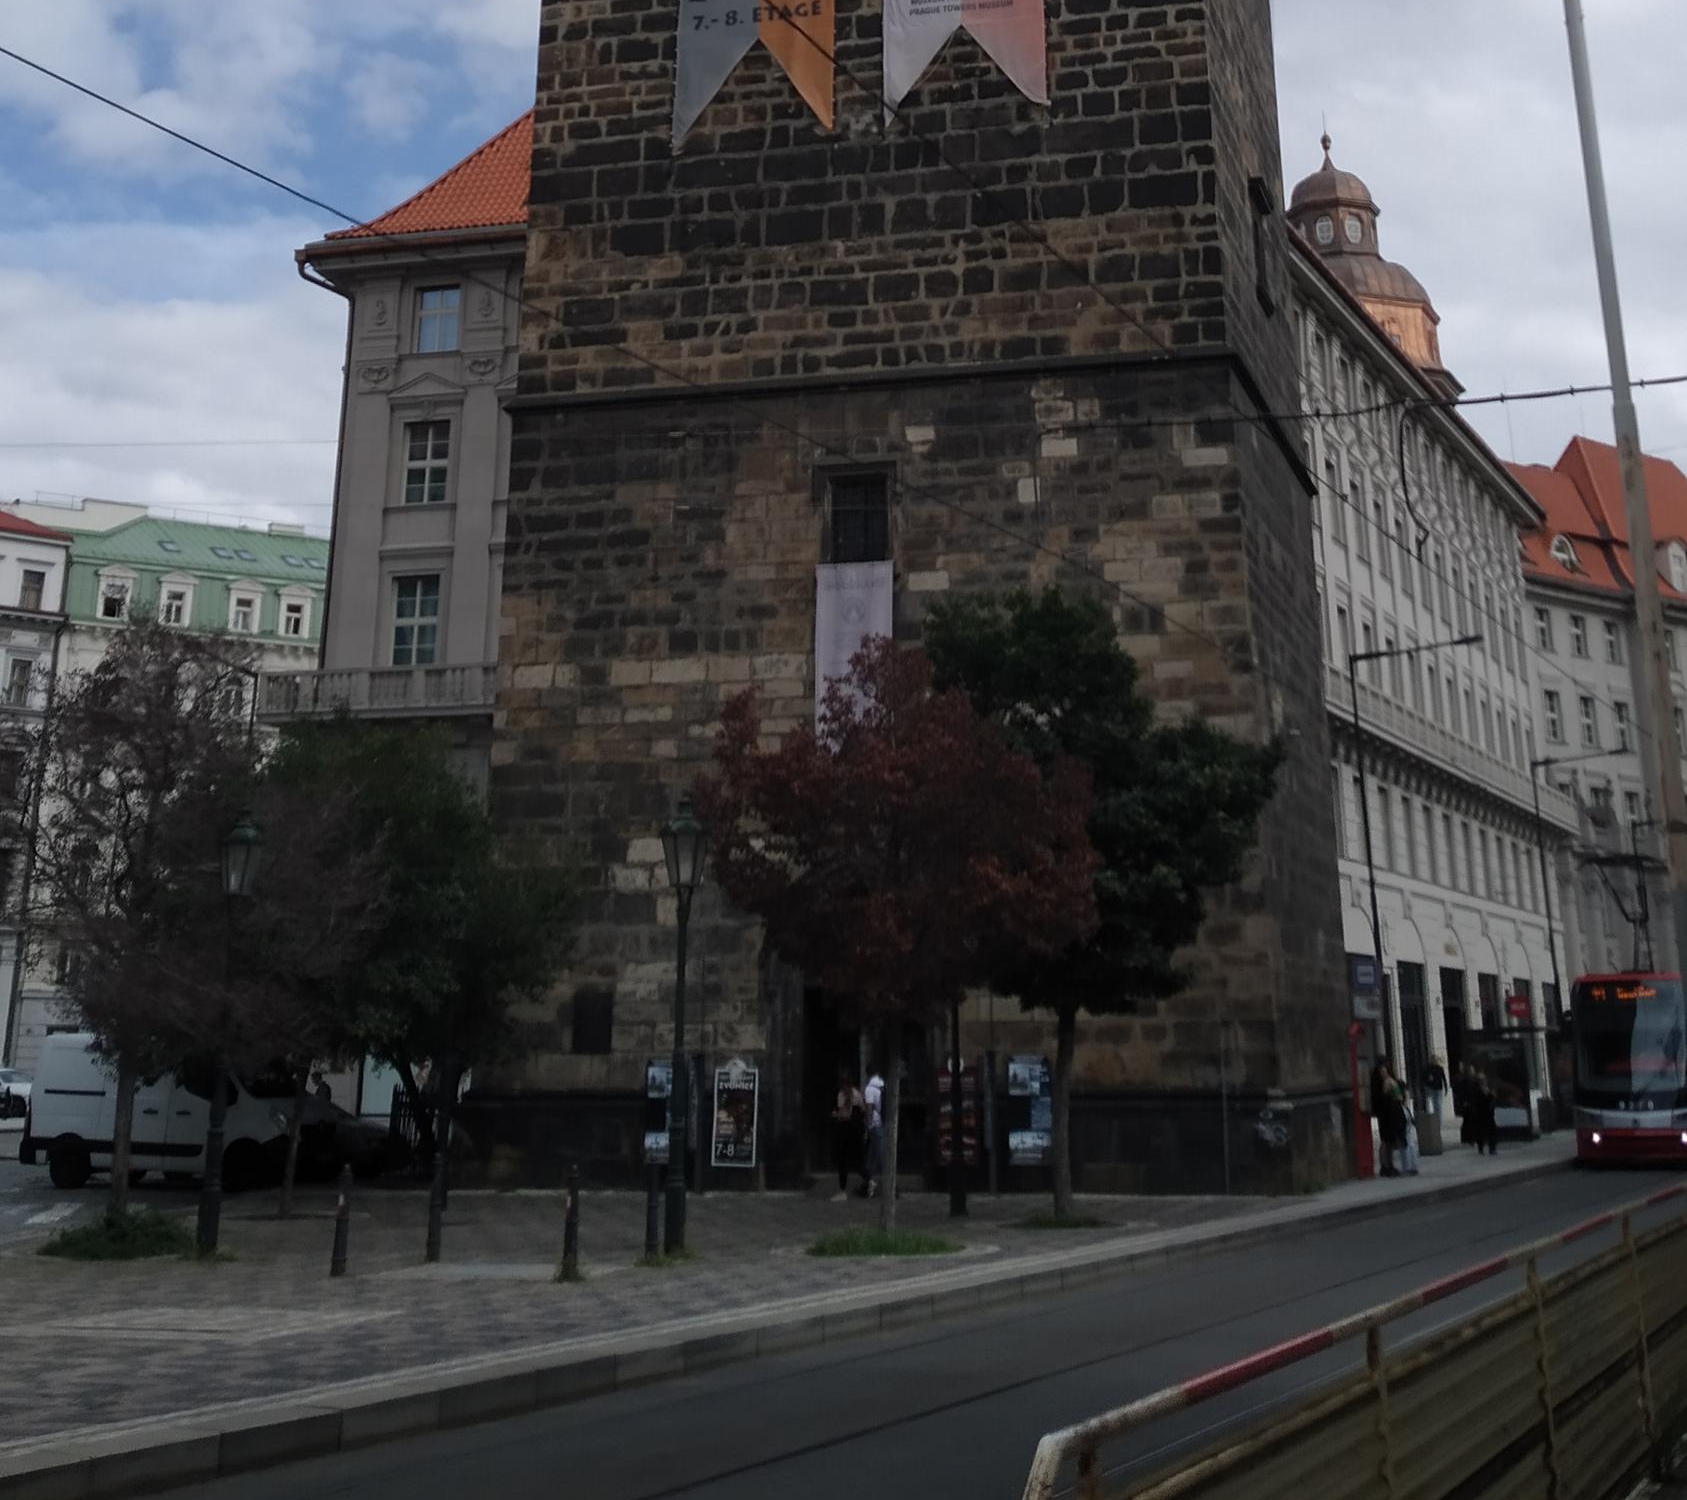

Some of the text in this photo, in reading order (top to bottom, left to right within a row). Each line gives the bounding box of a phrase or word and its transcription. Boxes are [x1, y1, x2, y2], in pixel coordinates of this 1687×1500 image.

[752, 0, 822, 22] ETAGE
[909, 0, 1014, 17] PRAGUE TOWERS MUSEUM
